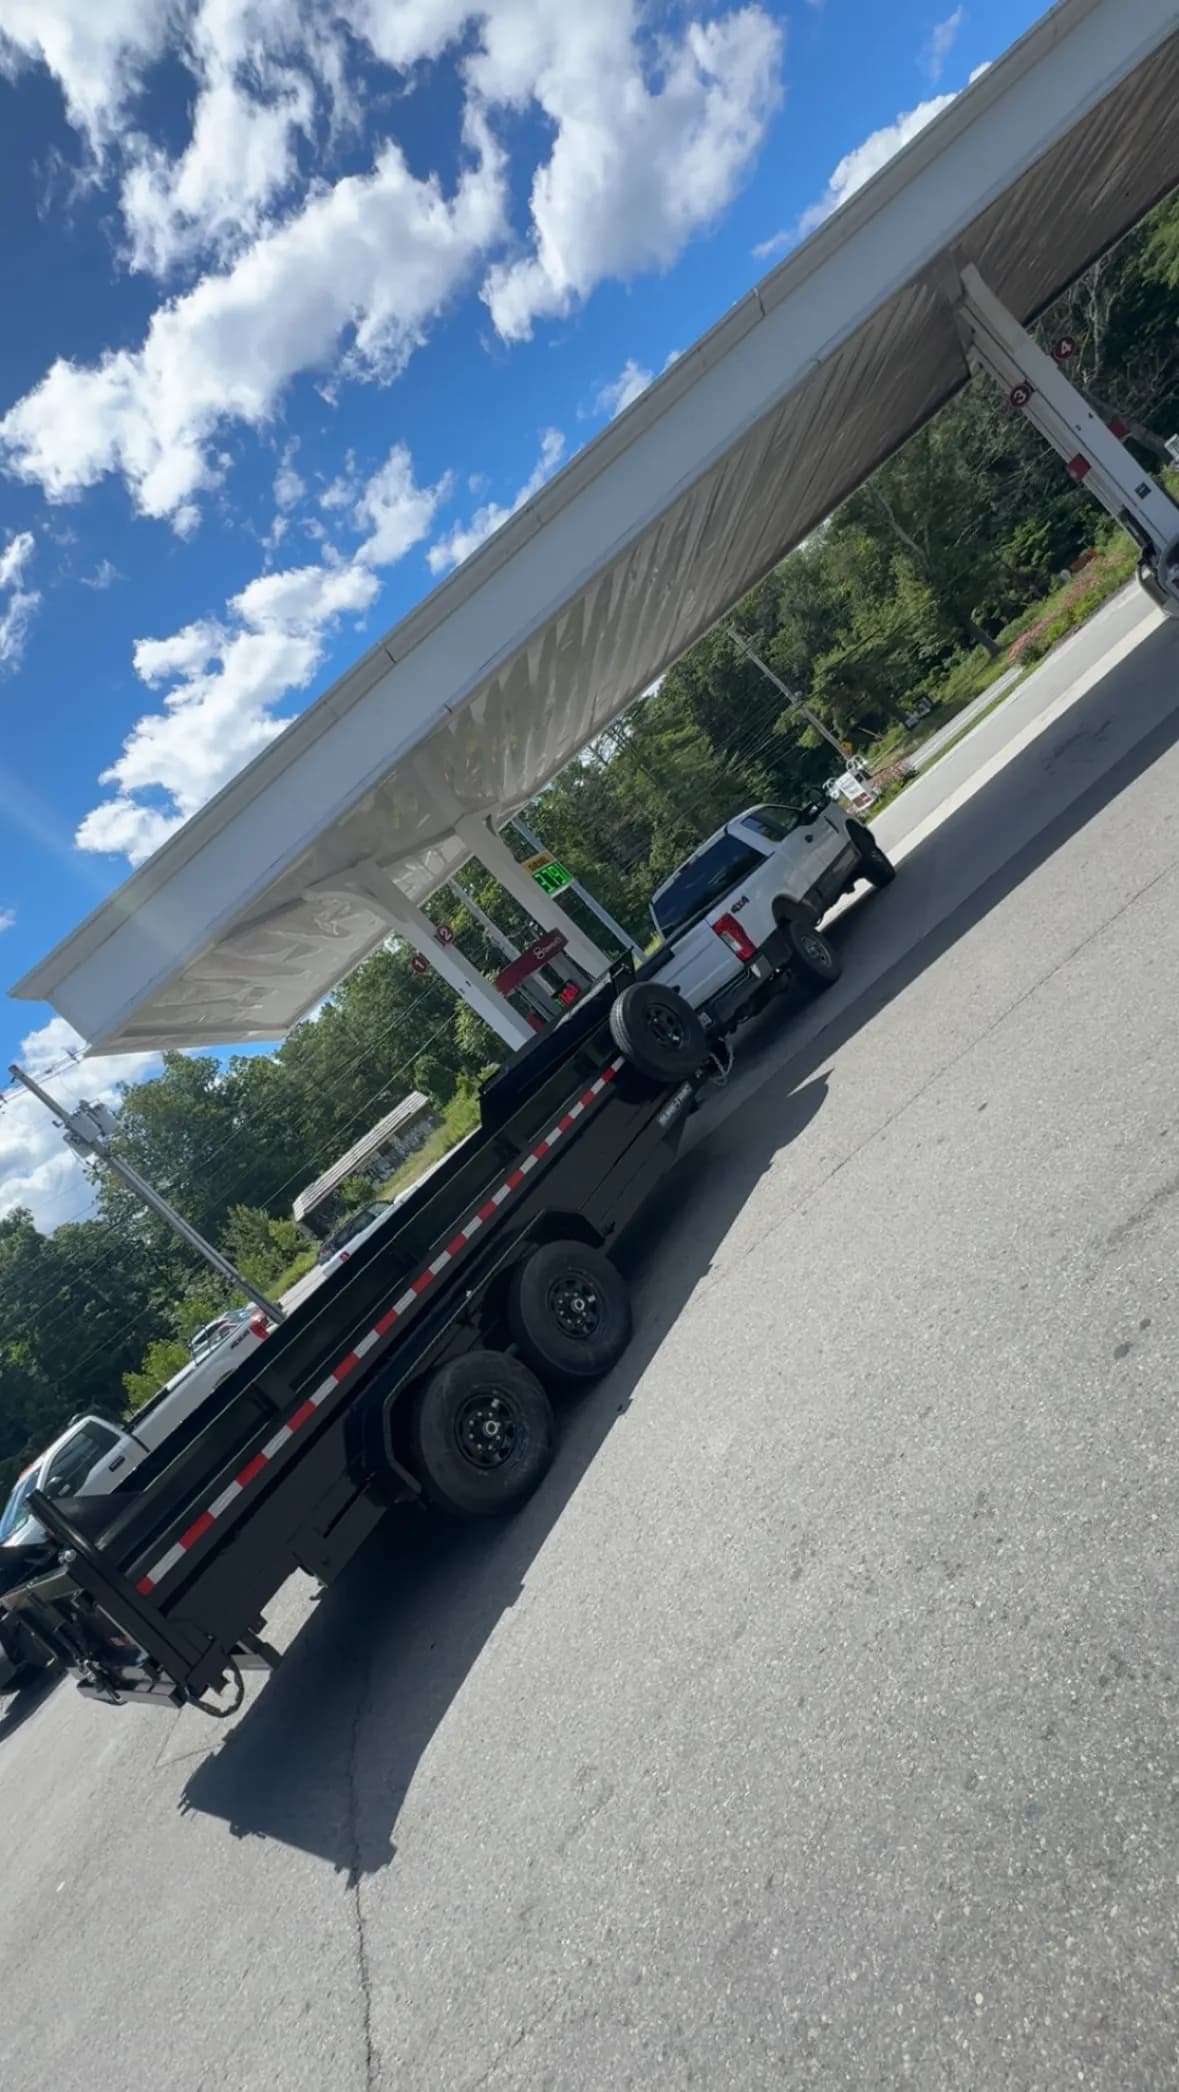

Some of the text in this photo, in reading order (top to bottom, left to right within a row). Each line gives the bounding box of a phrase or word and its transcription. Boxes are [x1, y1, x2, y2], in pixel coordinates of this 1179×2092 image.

[1061, 340, 1072, 355] 4
[1014, 389, 1027, 404] 3
[440, 927, 452, 941] 2
